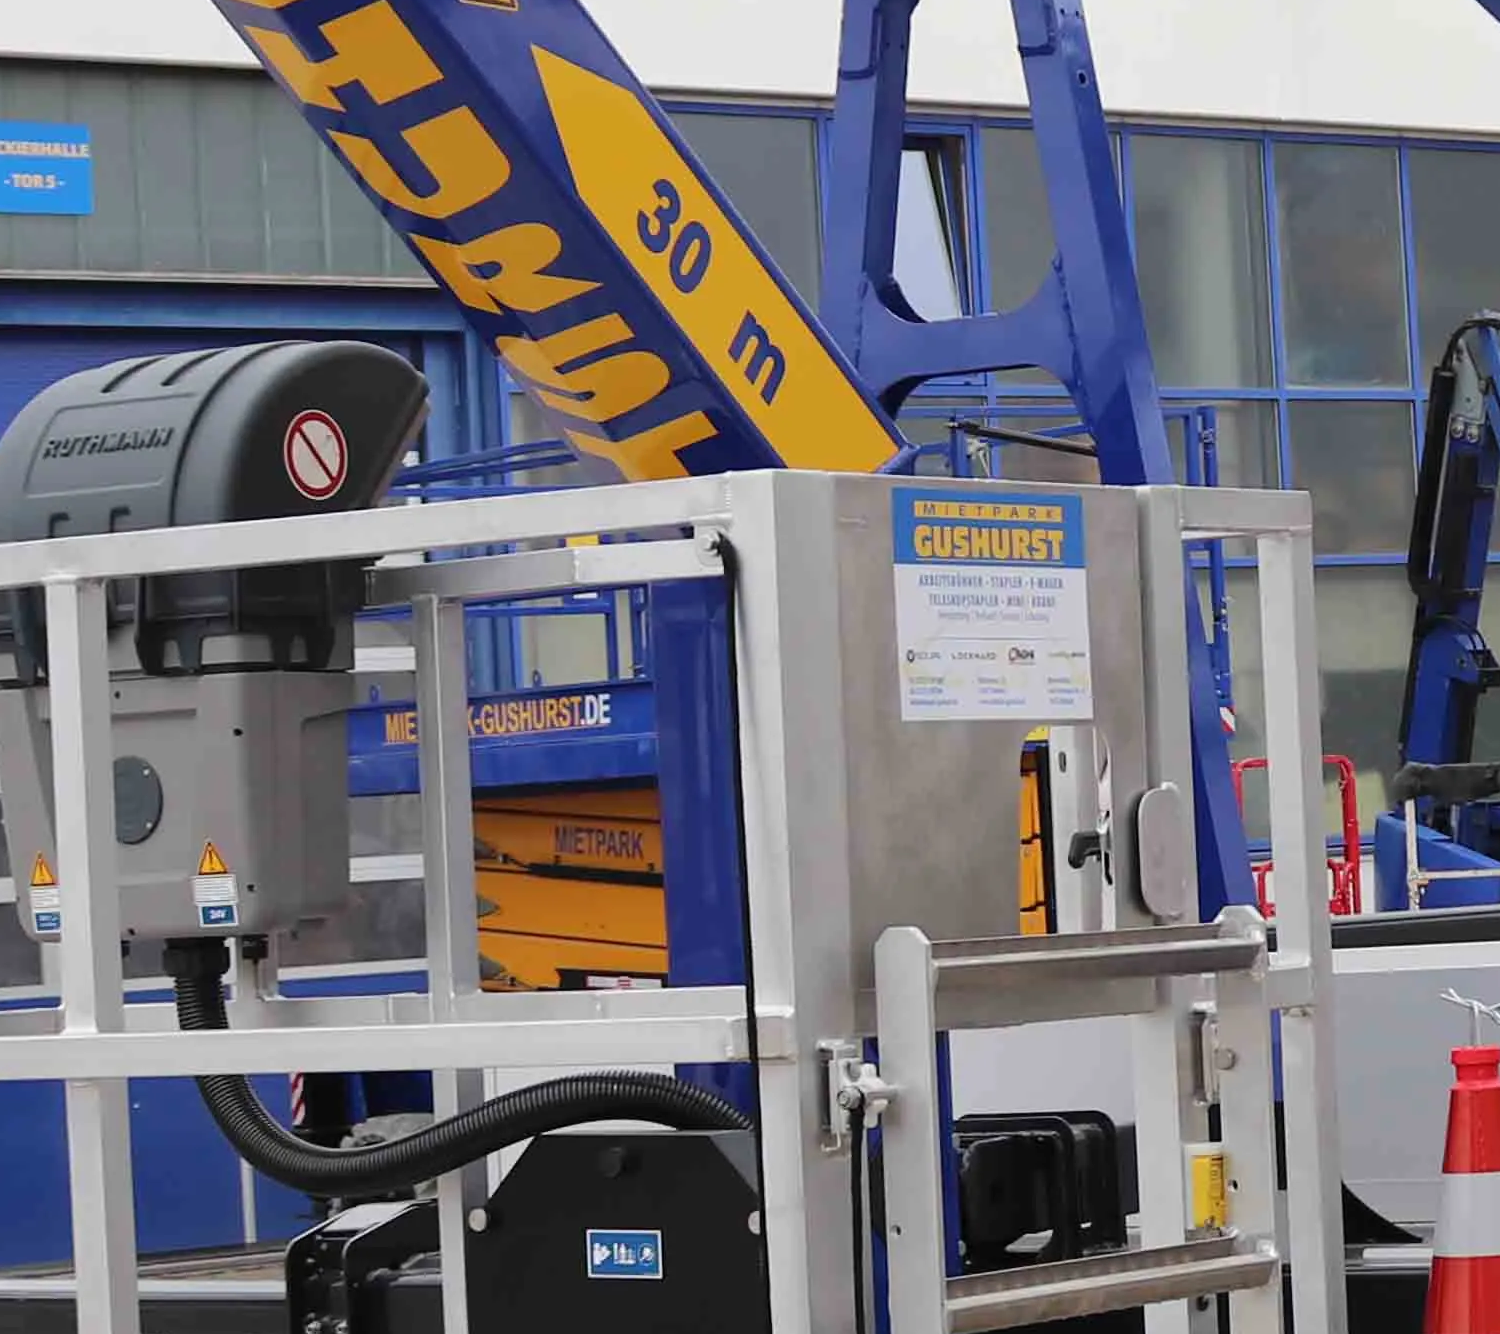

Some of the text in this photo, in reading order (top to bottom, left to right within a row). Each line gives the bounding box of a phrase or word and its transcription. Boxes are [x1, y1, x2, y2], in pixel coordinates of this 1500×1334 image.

[635, 178, 787, 406] 30 m
[42, 426, 175, 460] RUTHMANN
[923, 502, 1055, 519] MIETPARK
[913, 524, 1065, 560] GUSHURST
[554, 825, 644, 860] MIETPARK
